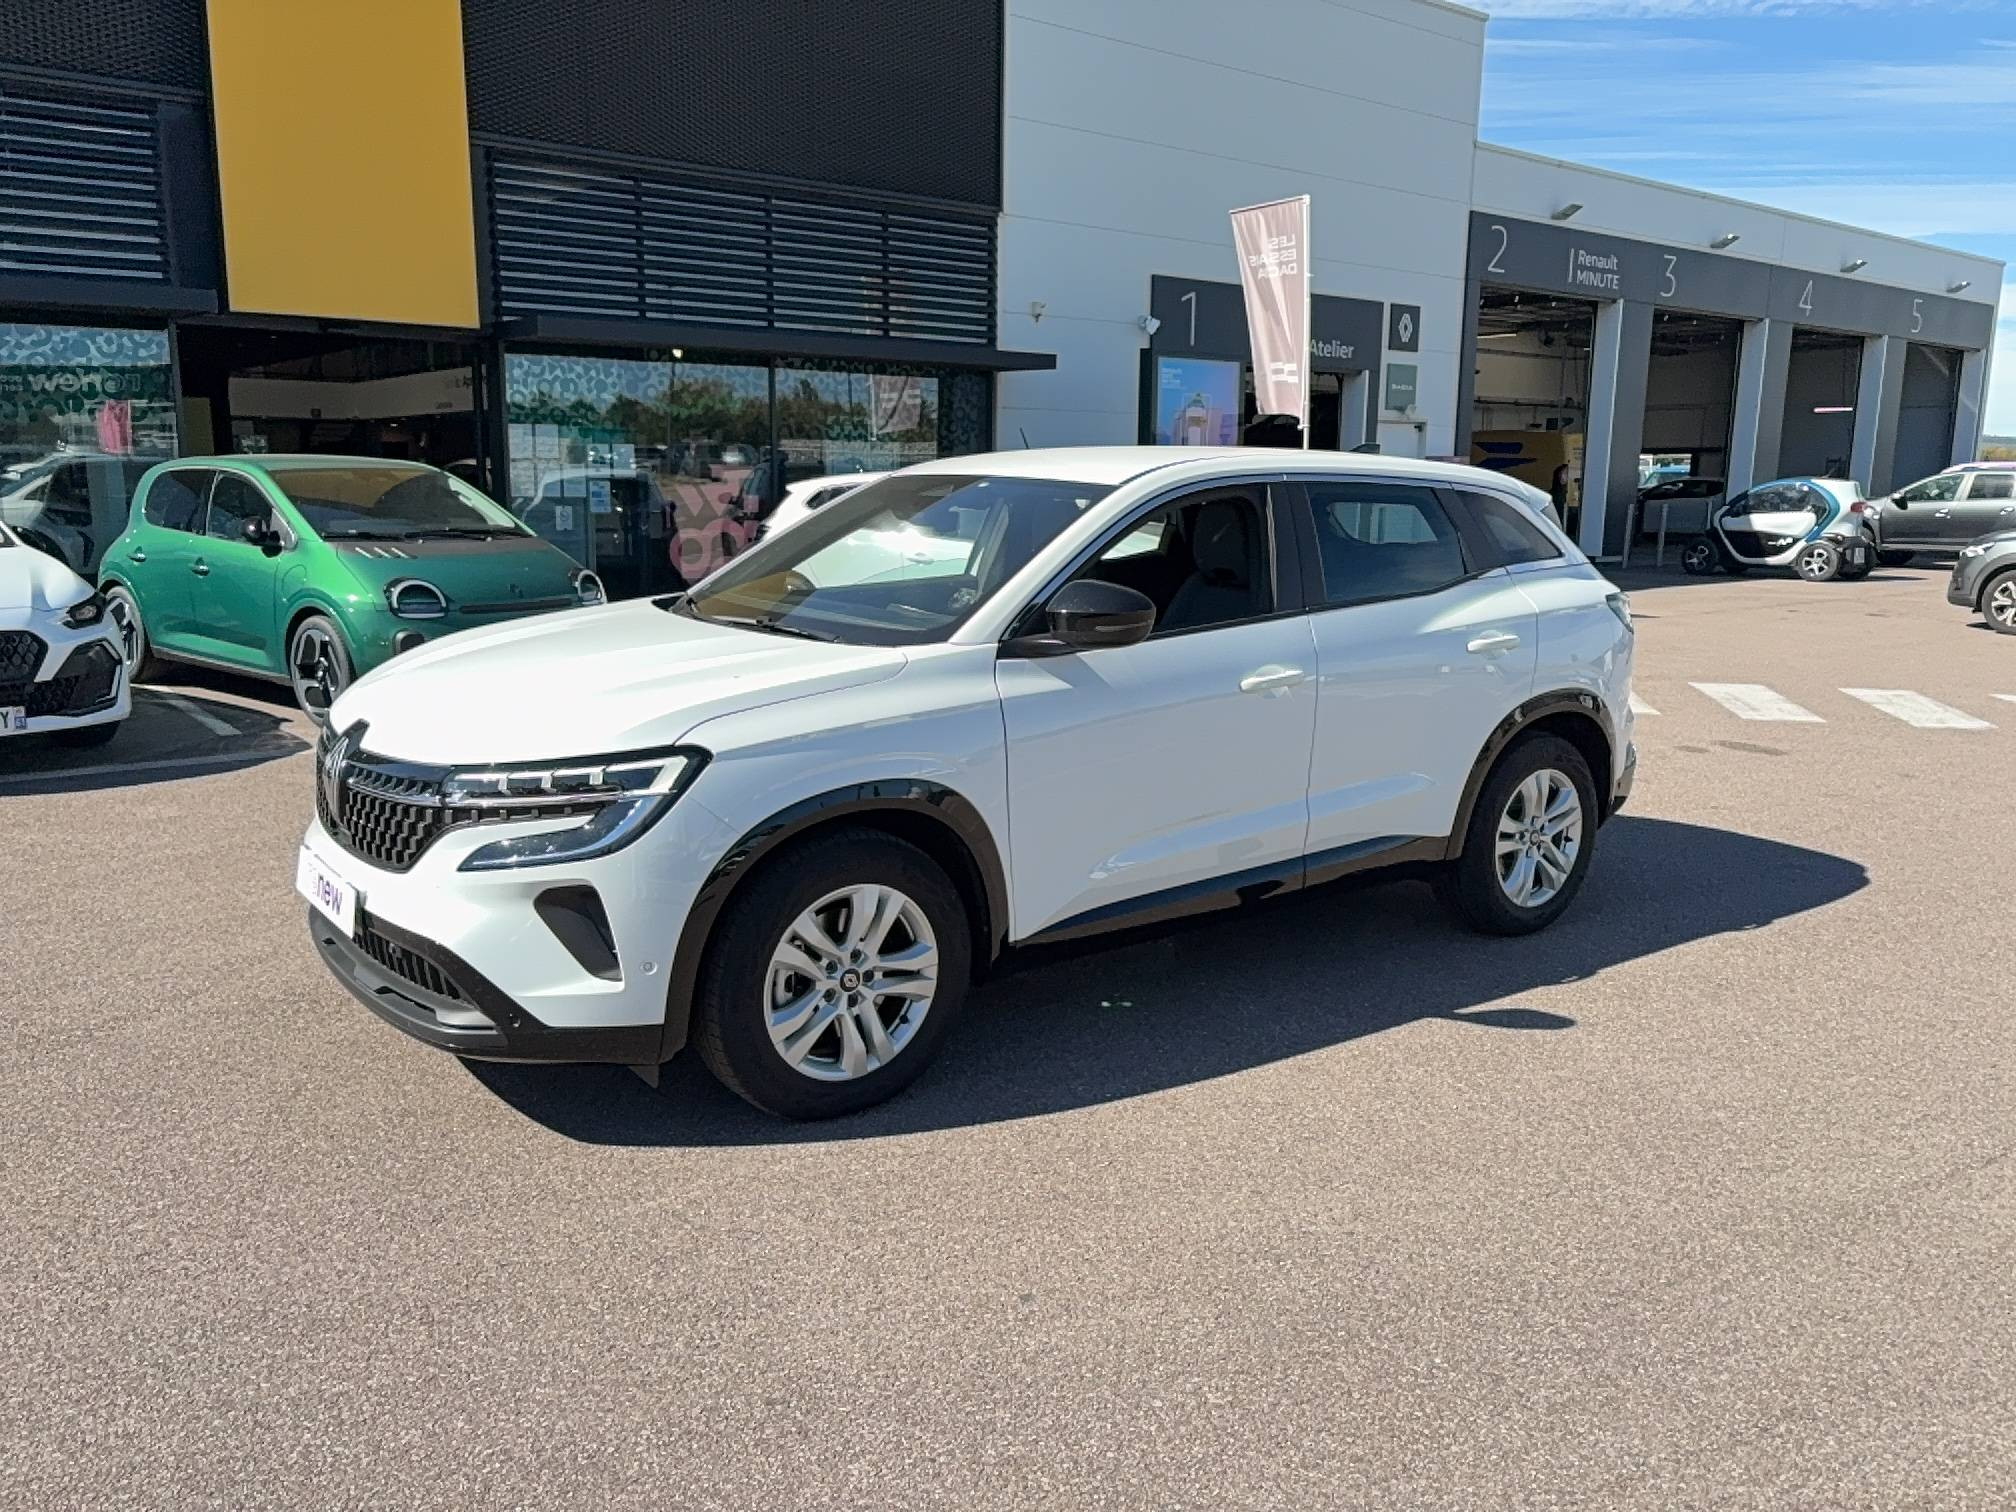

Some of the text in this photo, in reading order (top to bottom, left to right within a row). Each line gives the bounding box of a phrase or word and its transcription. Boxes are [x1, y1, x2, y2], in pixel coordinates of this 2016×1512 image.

[1487, 225, 1508, 273] 2
[1577, 250, 1619, 271] Renault
[1576, 270, 1620, 290] MINUTE
[1660, 254, 1677, 297] 3
[1798, 279, 1813, 318] 4
[1910, 298, 1924, 334] 5
[1181, 291, 1197, 347] 1
[1309, 338, 1355, 359] Atelier
[309, 864, 343, 916] new
